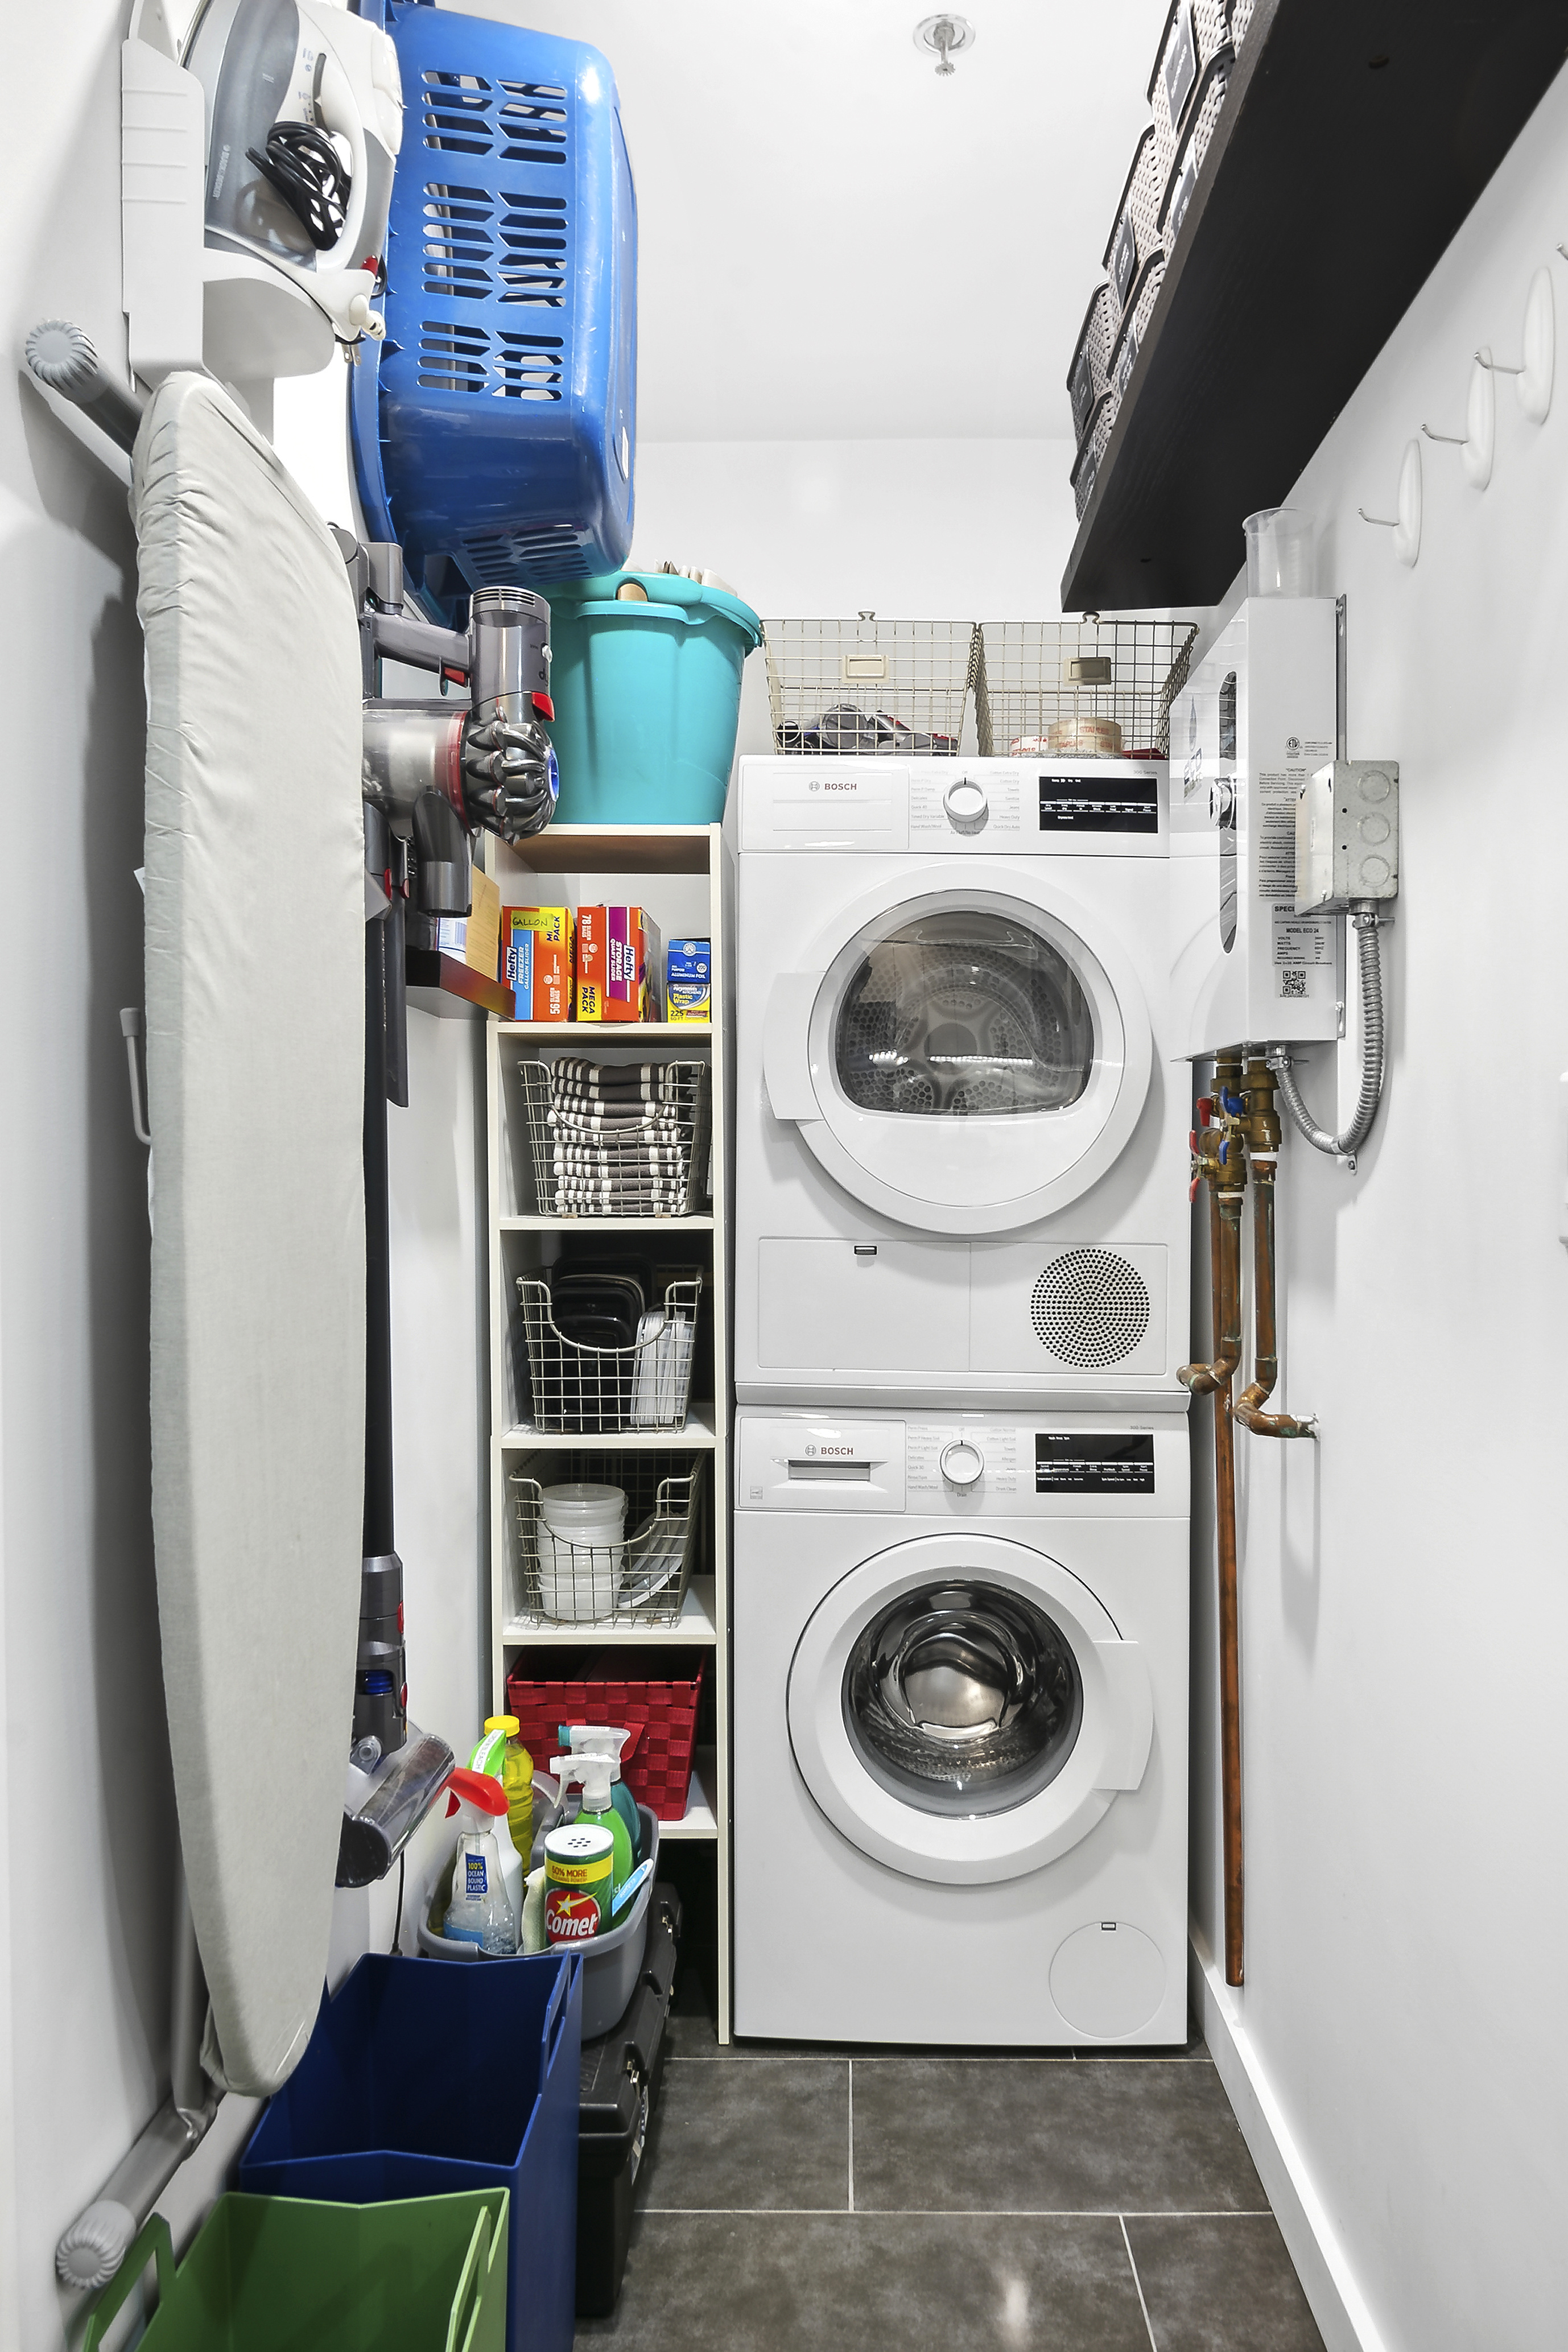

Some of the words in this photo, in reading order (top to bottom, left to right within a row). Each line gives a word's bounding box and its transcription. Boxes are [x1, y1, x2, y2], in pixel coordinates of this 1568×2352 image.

[513, 917, 547, 926] GALLON
[581, 914, 592, 925] 78
[507, 948, 517, 979] Hefty
[625, 947, 634, 979] Hefty
[550, 1002, 560, 1014] 56
[546, 1909, 599, 1937] Comet
